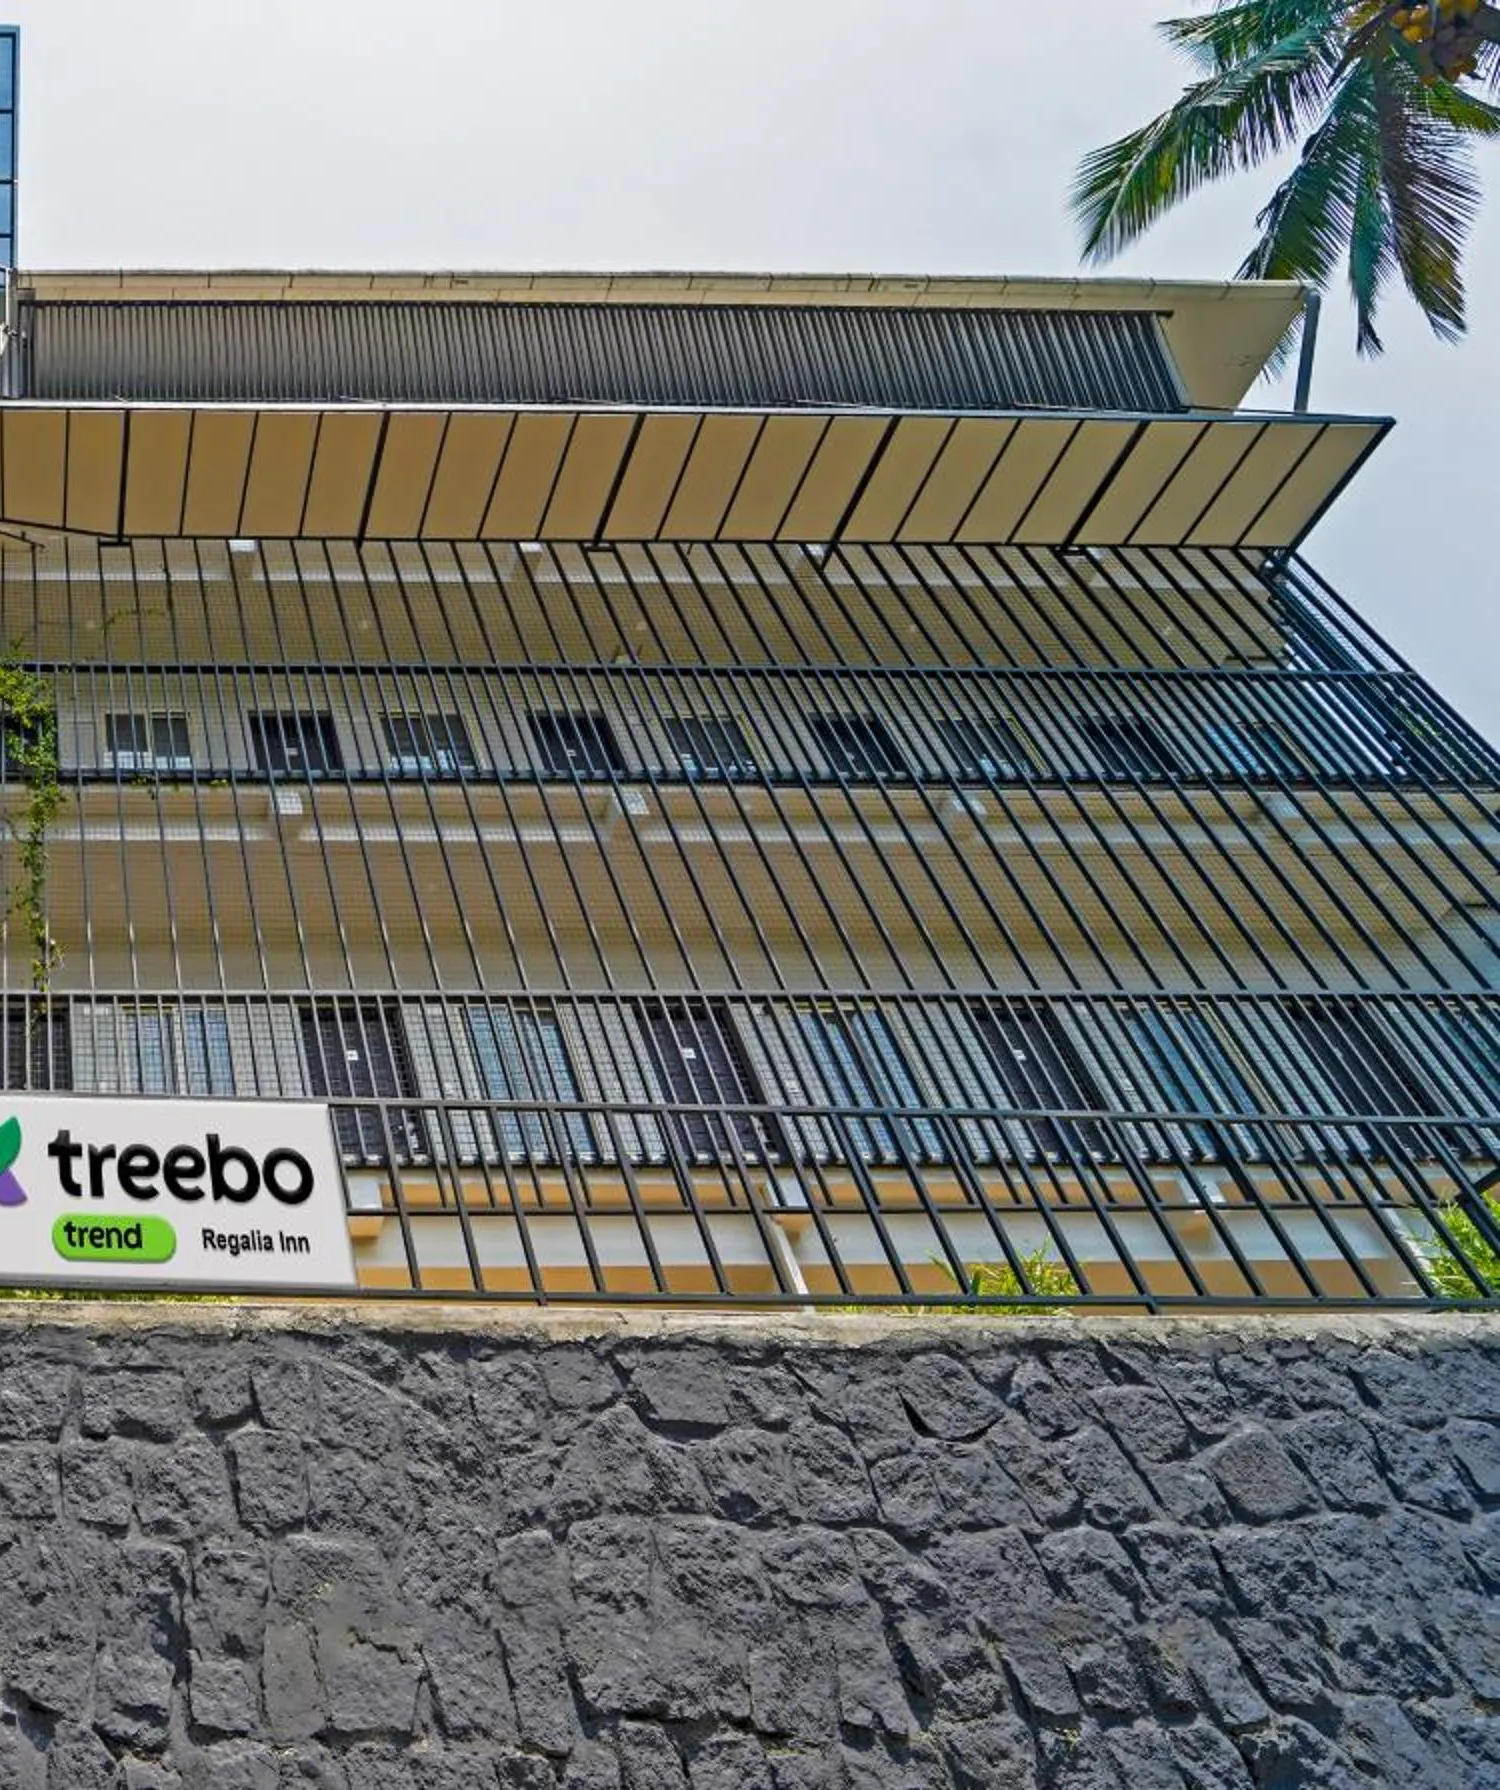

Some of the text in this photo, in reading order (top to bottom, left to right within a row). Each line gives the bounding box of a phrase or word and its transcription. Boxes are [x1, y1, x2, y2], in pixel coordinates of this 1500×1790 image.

[47, 1129, 314, 1205] treebo
[63, 1221, 143, 1249] trend
[202, 1228, 310, 1257] Regalia Inn
